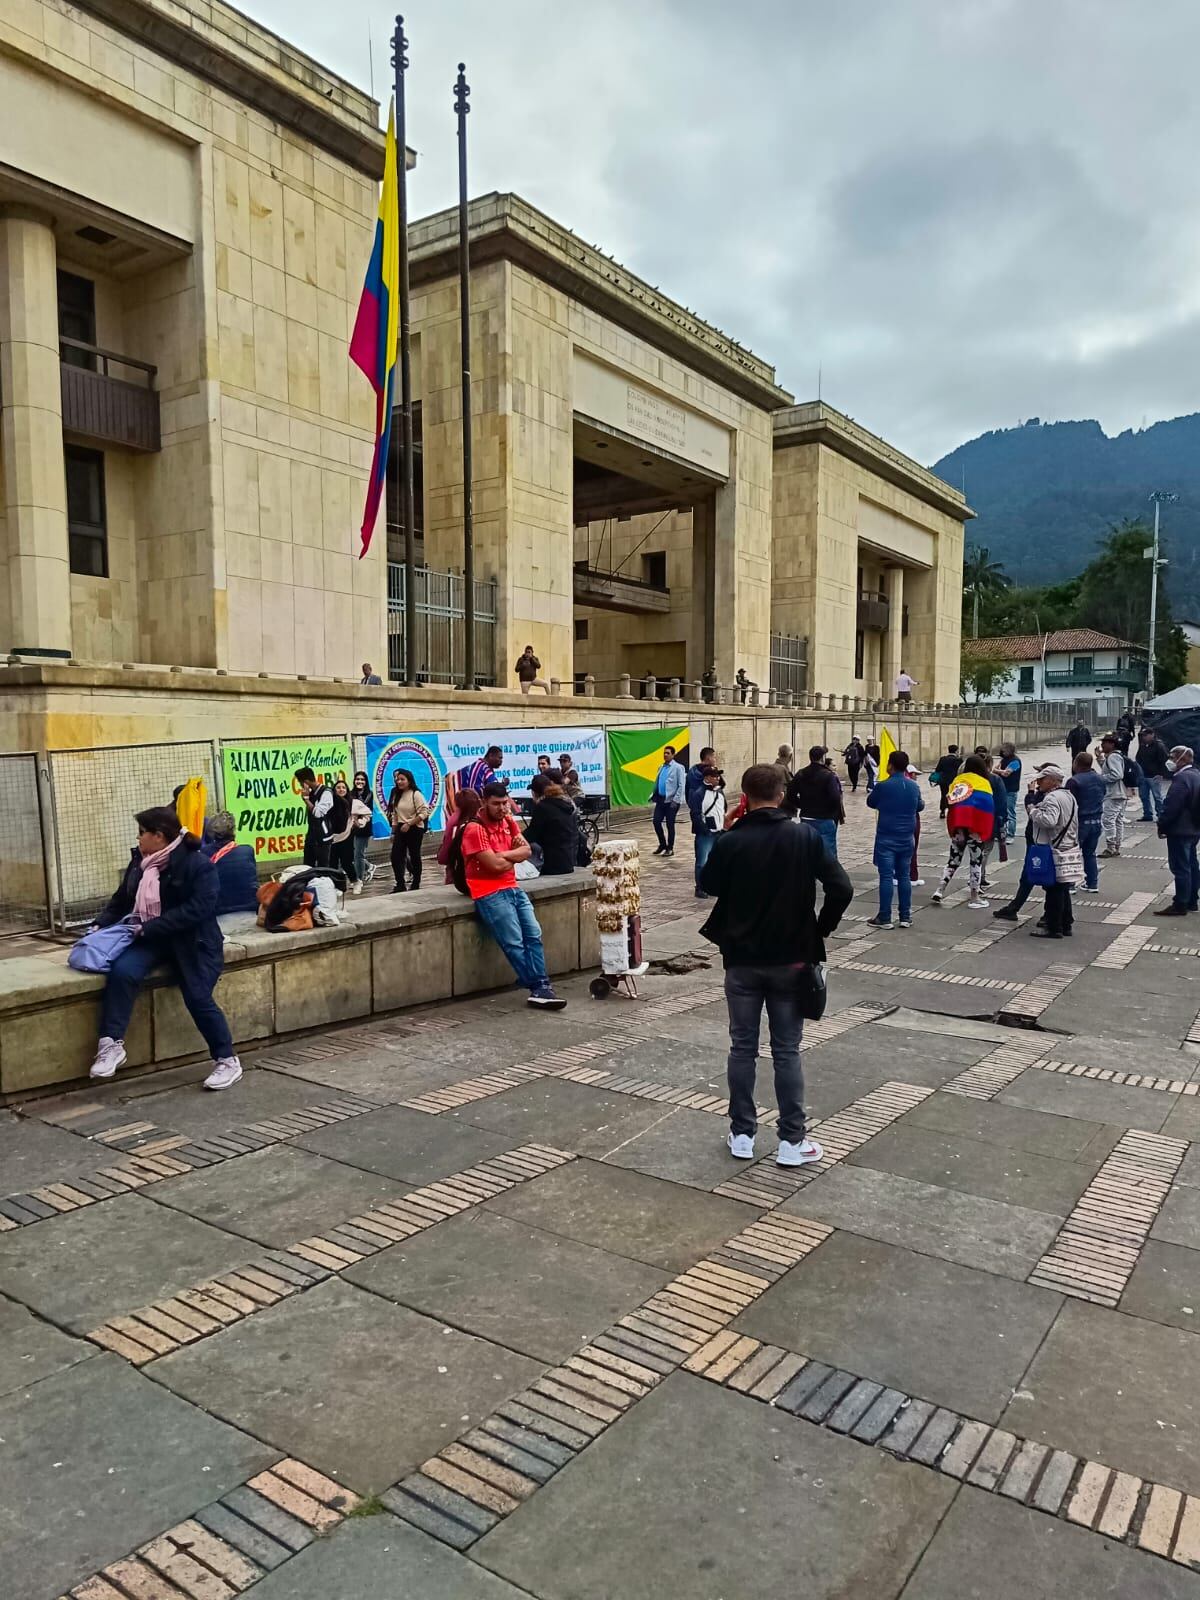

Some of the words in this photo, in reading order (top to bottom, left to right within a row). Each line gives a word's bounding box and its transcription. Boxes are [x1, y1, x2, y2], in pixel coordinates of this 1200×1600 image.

[502, 745, 513, 753] az
[514, 743, 530, 755] por
[231, 750, 290, 772] ALIANZA
[513, 765, 535, 777] todos
[581, 762, 588, 772] la
[237, 777, 278, 799] APOYA
[280, 780, 290, 794] EL
